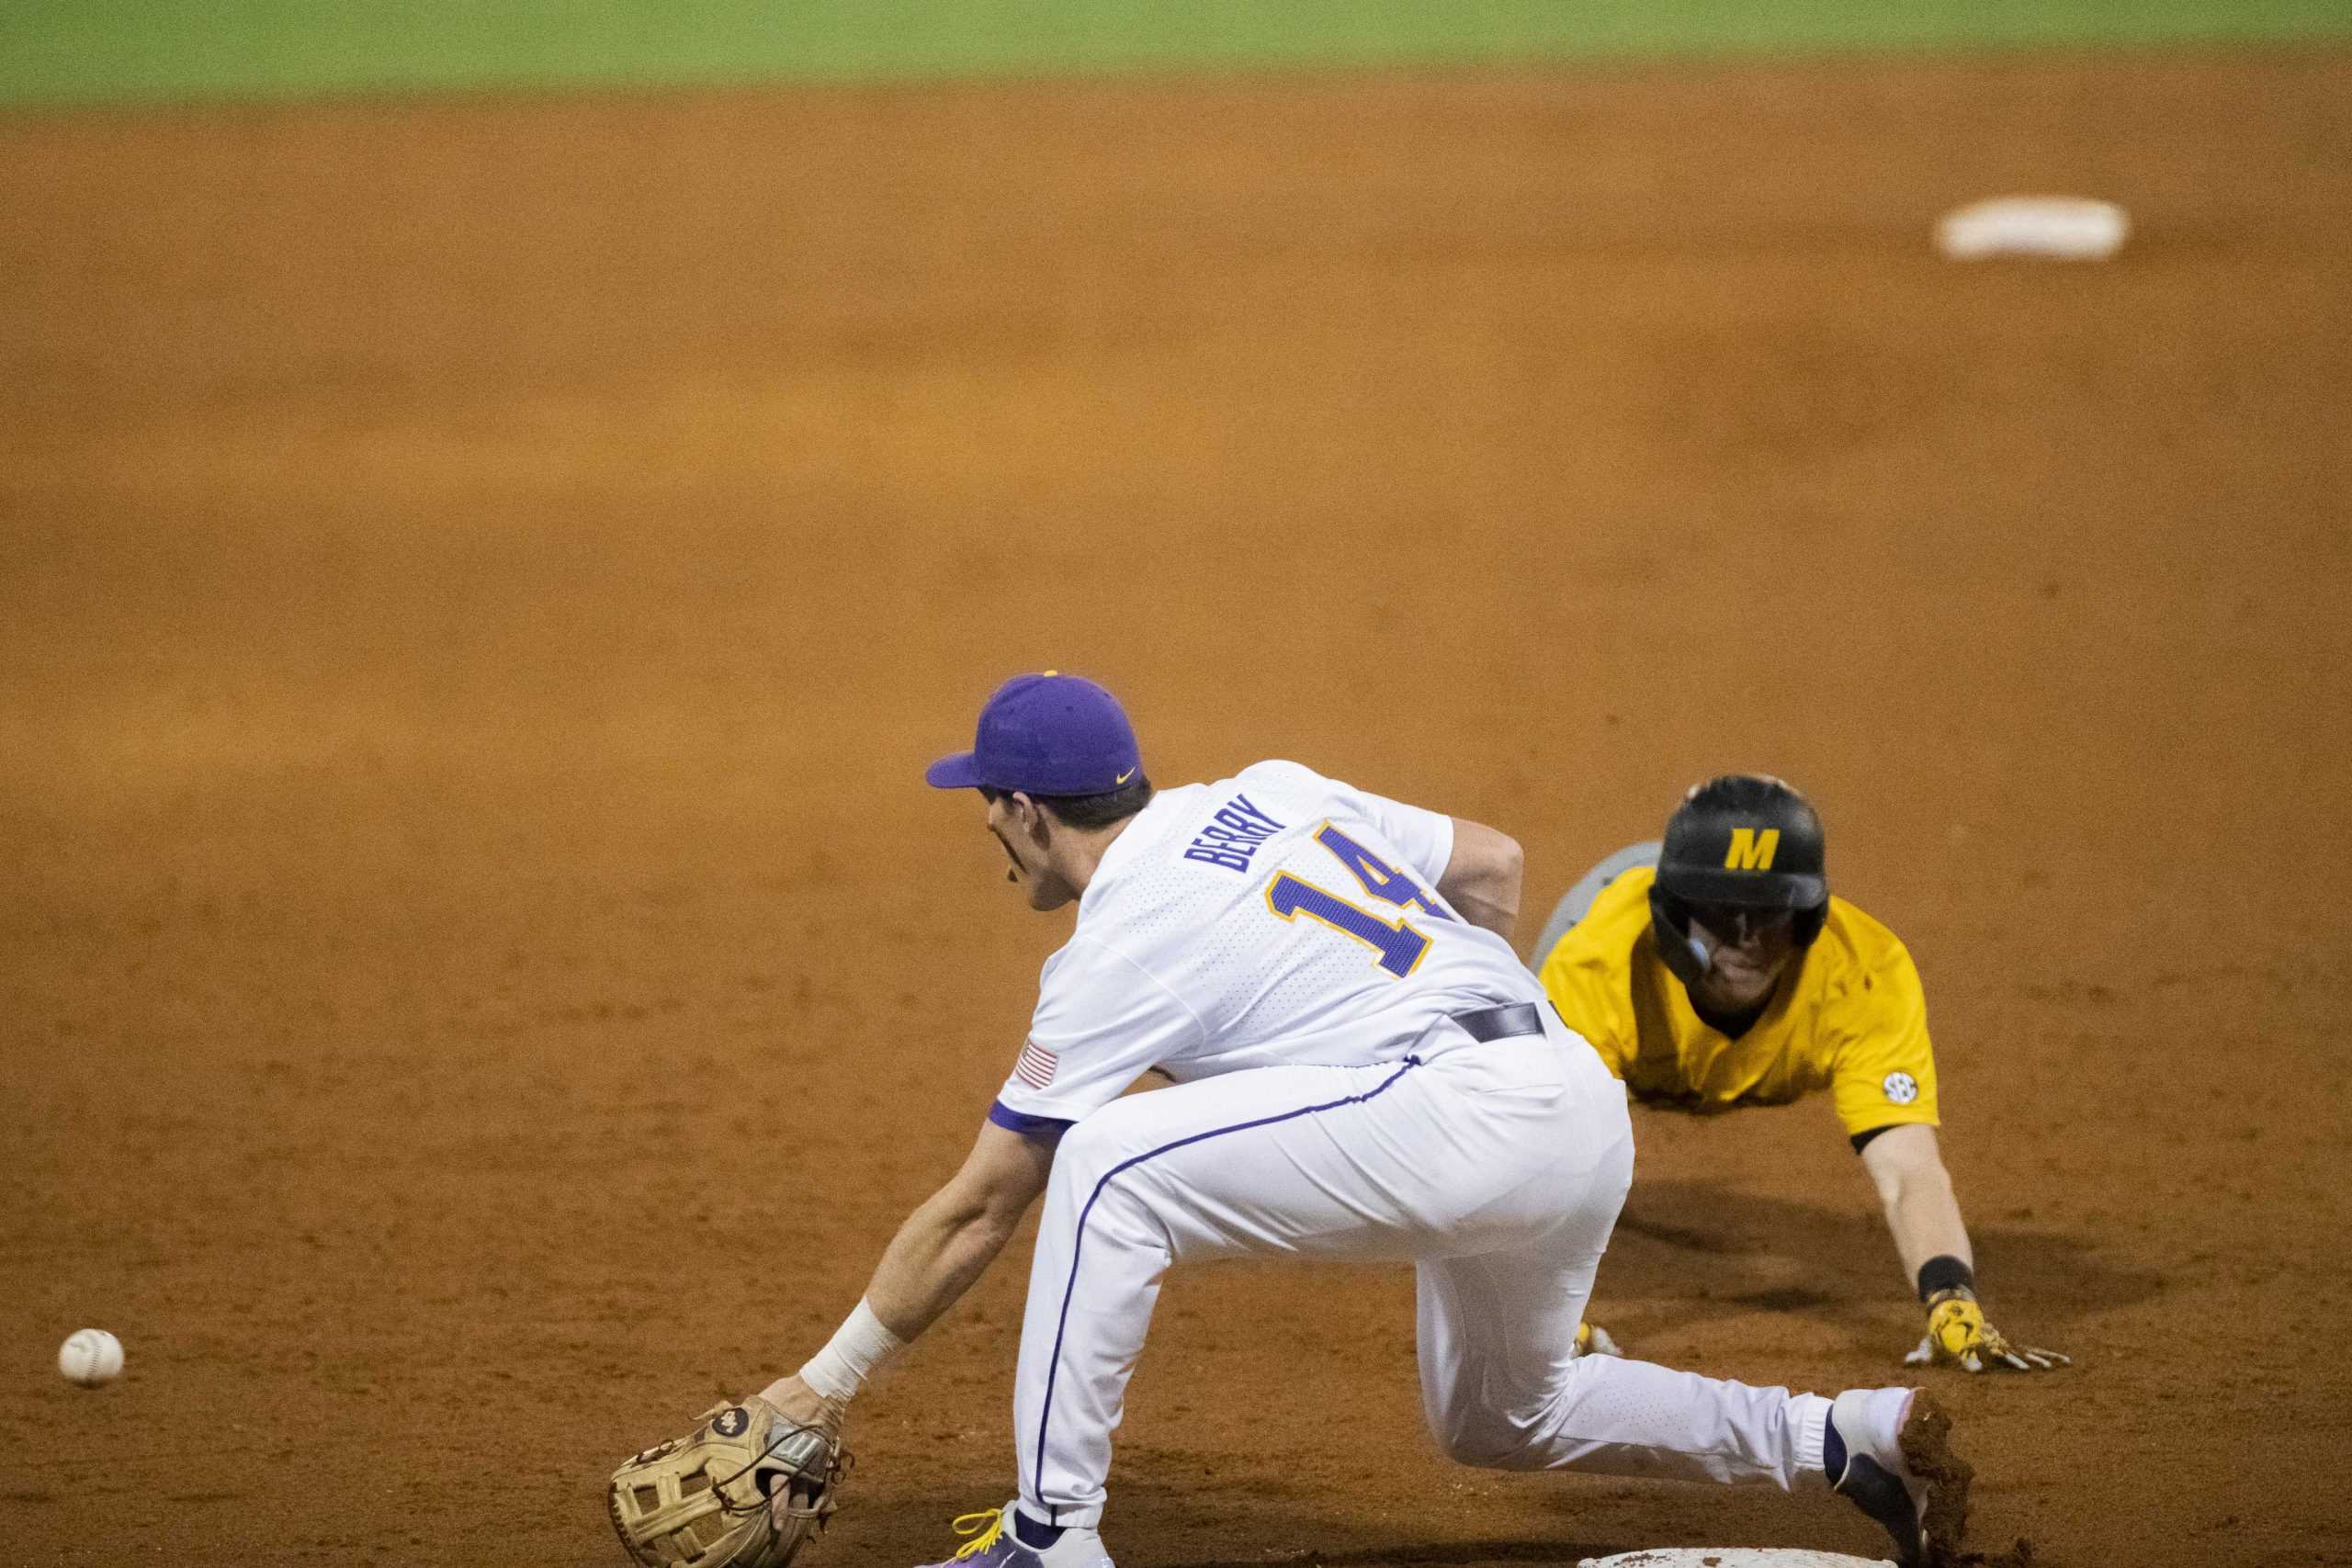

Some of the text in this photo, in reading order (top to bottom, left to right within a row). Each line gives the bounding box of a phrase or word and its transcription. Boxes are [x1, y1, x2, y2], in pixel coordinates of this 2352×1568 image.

[1183, 794, 1286, 874] BERRY
[1724, 828, 1780, 871] M
[1264, 818, 1456, 981] 14
